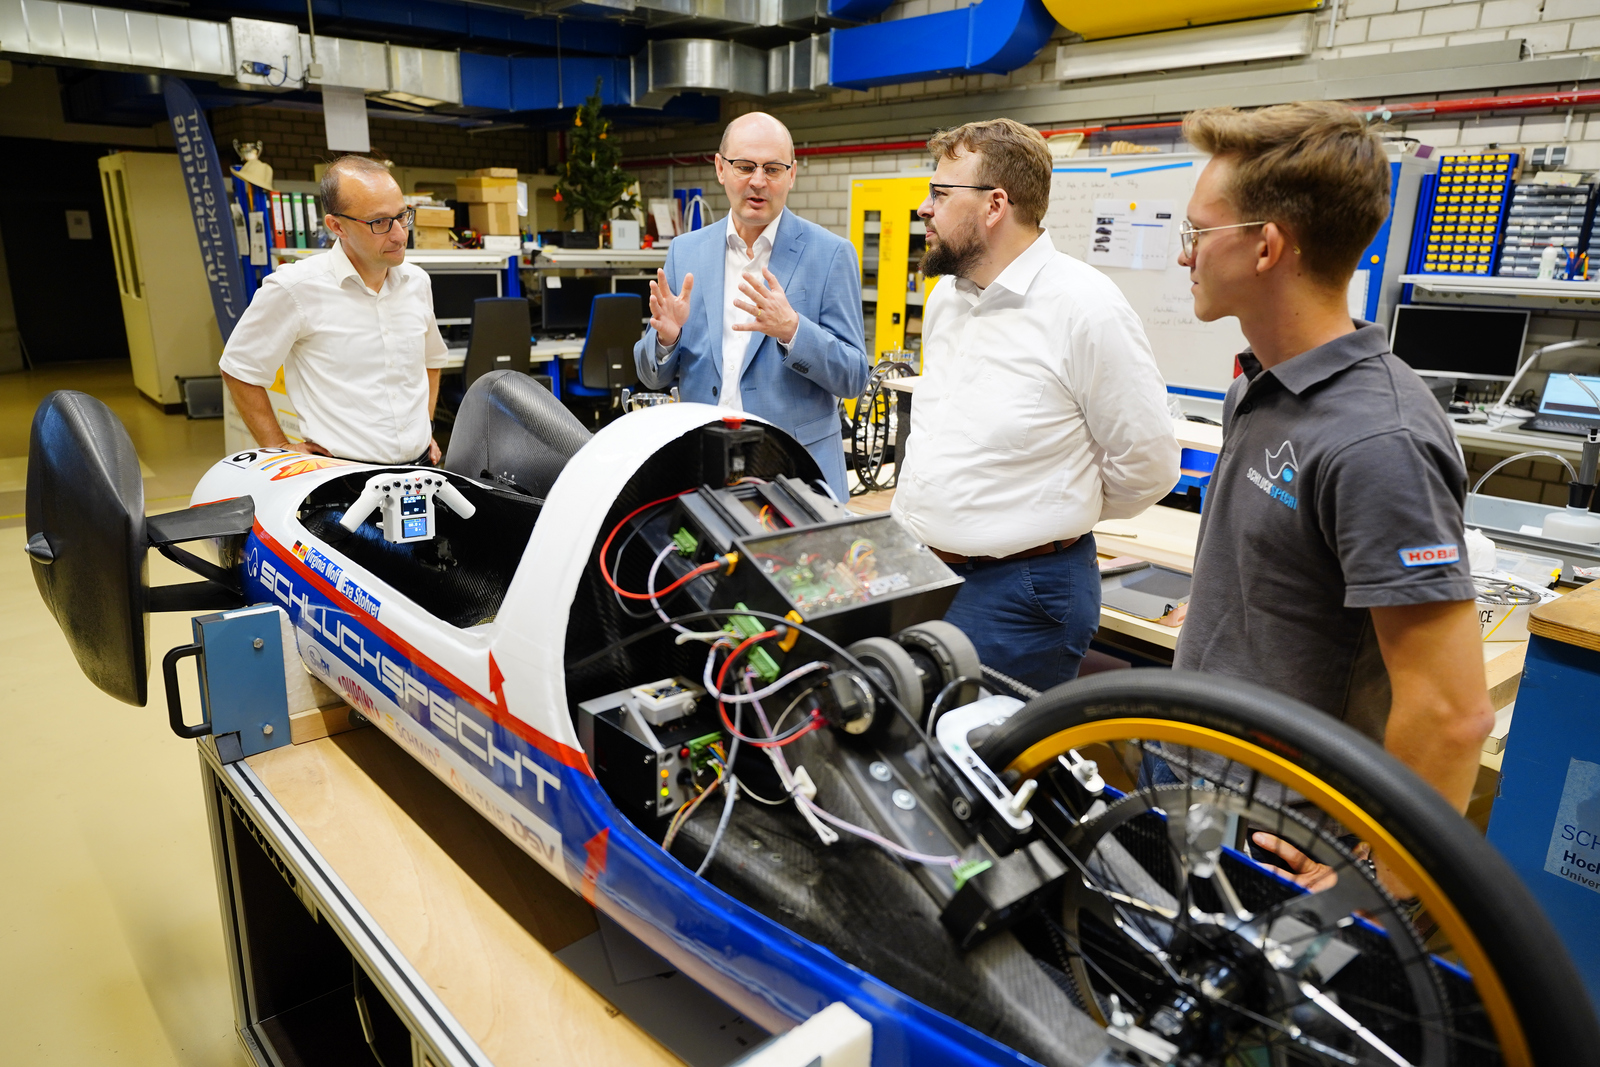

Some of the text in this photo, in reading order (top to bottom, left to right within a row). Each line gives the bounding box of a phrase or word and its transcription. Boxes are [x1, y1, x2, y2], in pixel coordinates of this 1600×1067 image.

[340, 576, 380, 617] Eva Stohrer
[259, 559, 561, 805] SCHLUCKSPECHT
[395, 721, 437, 767] SCHMID
[510, 813, 555, 864] DSV
